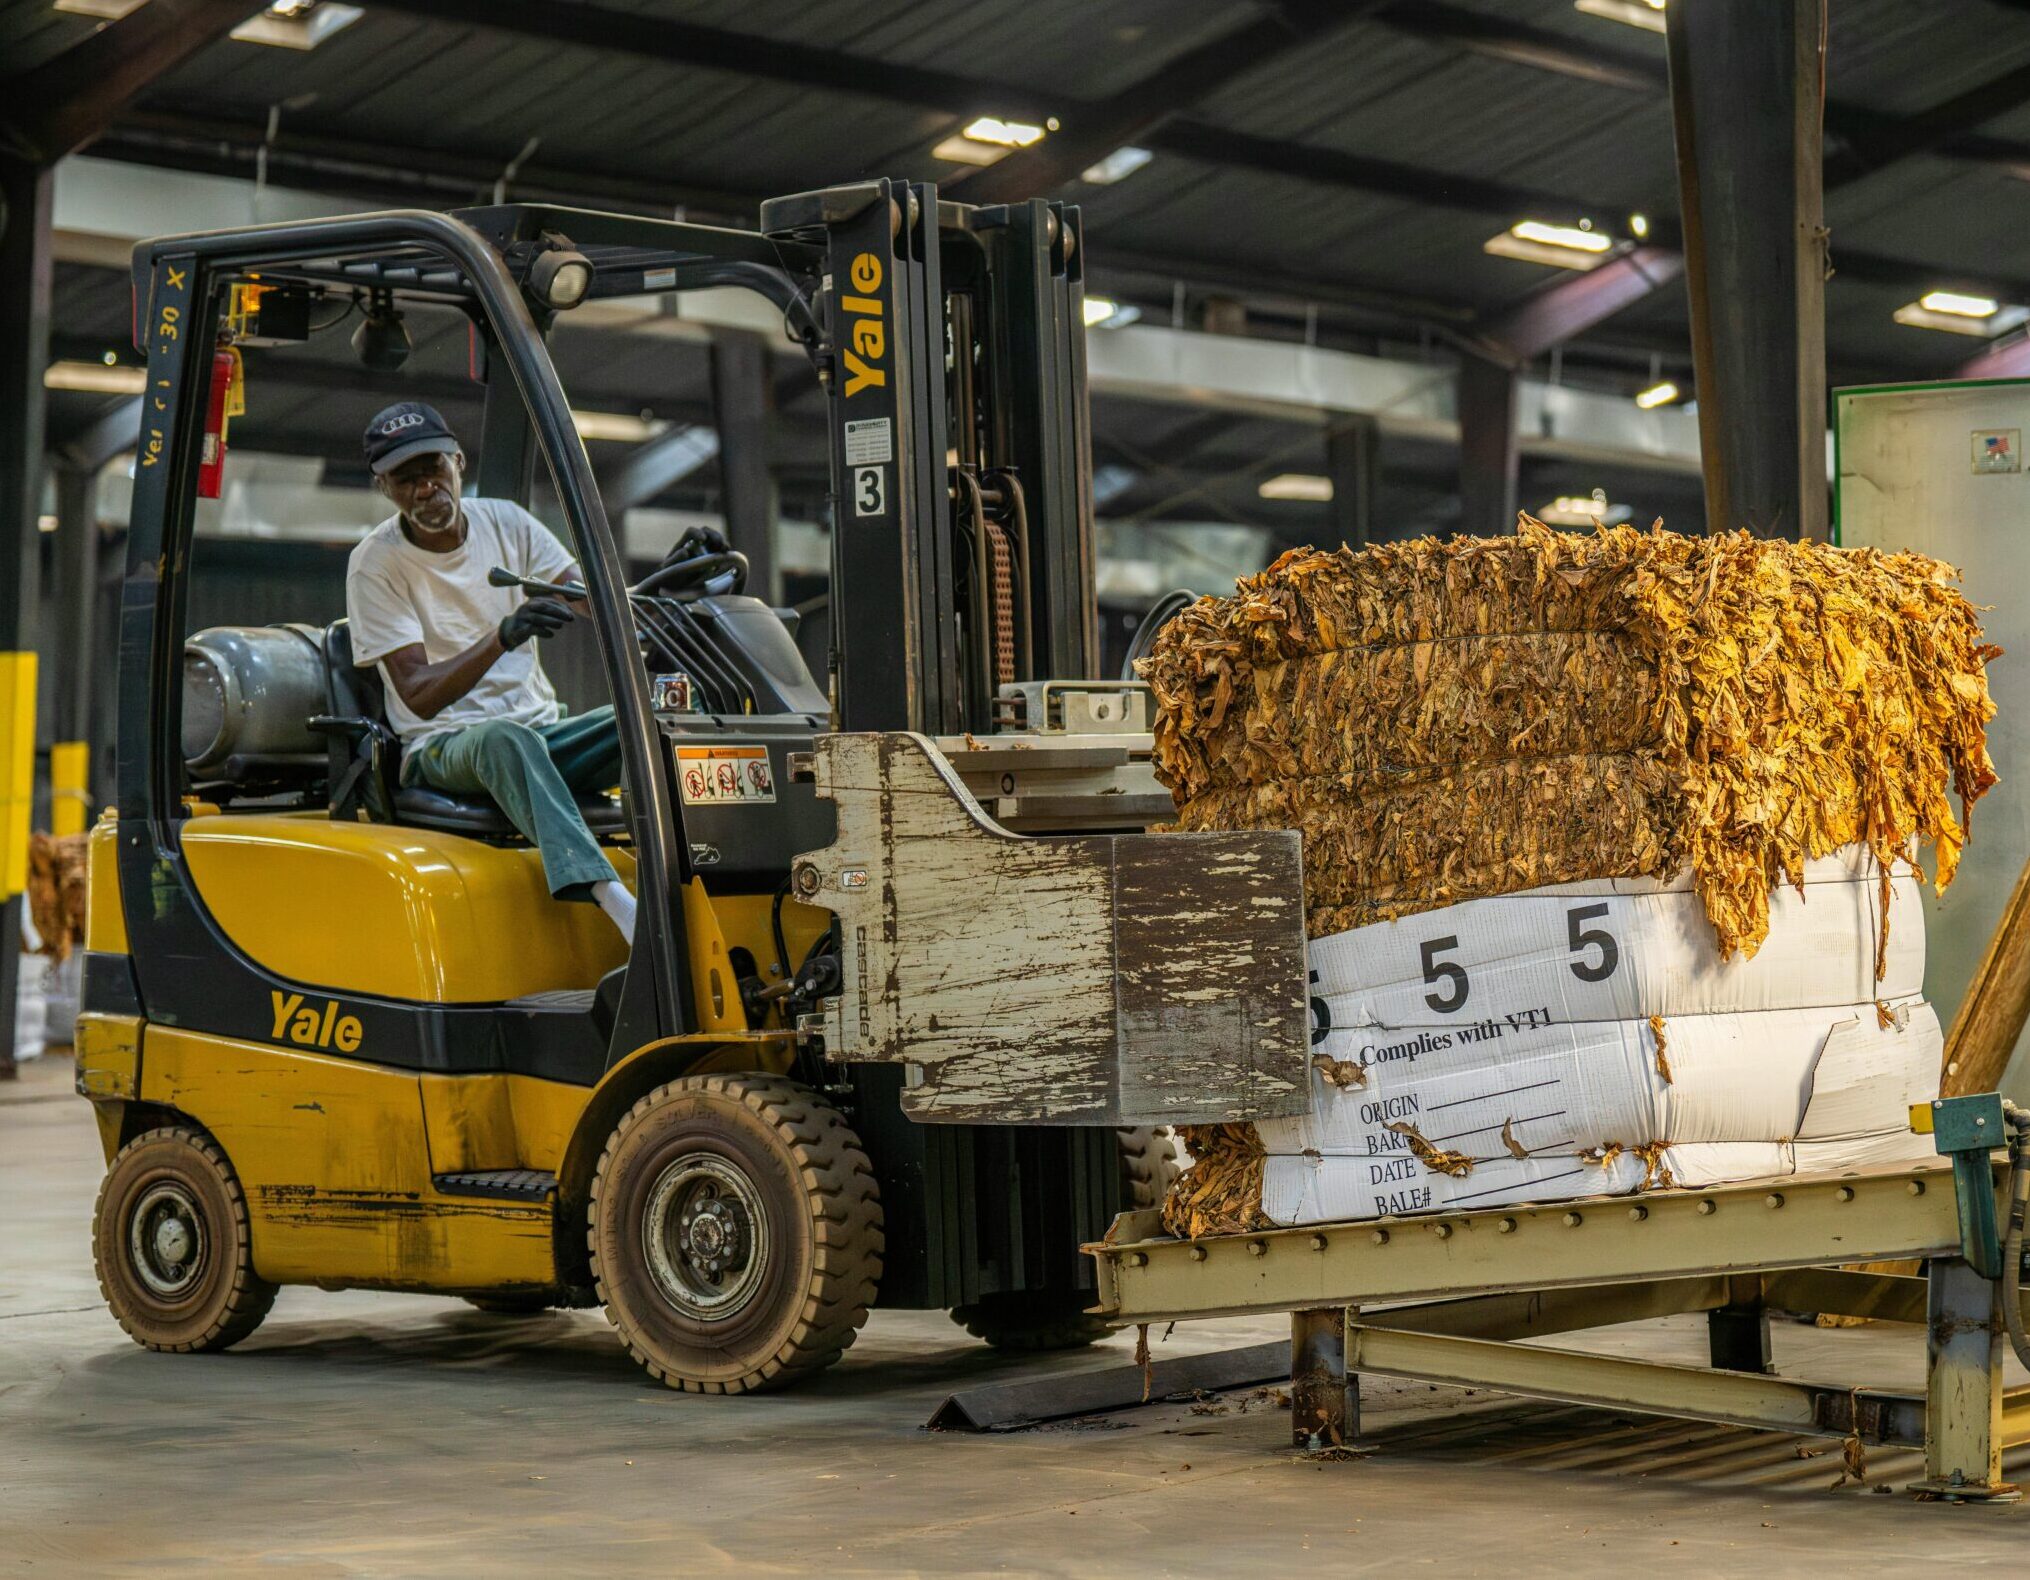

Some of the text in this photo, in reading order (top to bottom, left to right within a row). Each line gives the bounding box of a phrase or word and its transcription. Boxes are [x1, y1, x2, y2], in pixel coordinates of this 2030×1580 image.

[842, 253, 886, 398] Yale
[859, 470, 881, 513] 3
[856, 924, 870, 1038] cascade
[1420, 935, 1469, 1013] 5
[1567, 903, 1619, 982] 5
[271, 990, 363, 1053] Yale
[1359, 1006, 1552, 1067] Complies with VT1
[1360, 1093, 1420, 1125] ORIGIN
[1369, 1157, 1417, 1186] DATE
[1374, 1186, 1431, 1216] BALE#
